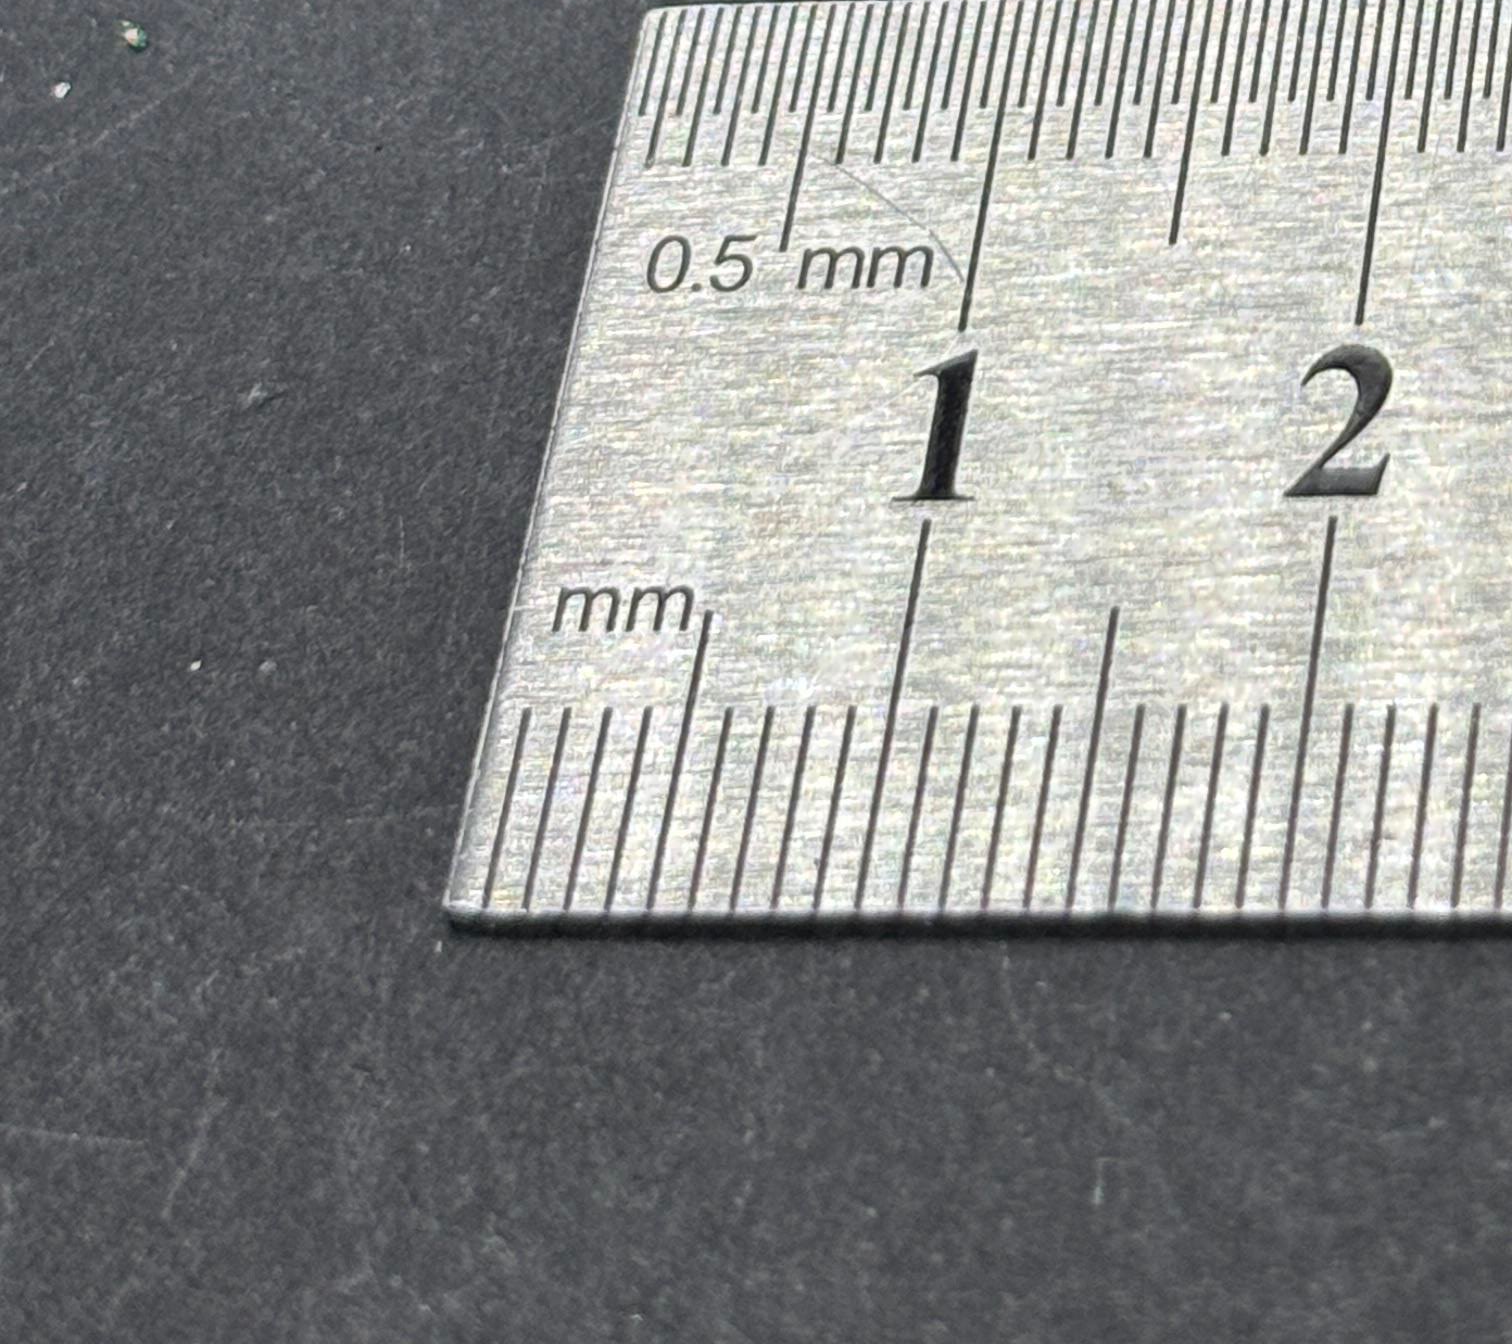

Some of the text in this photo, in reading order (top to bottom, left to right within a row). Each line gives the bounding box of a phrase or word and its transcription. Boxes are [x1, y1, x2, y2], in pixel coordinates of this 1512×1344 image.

[645, 234, 935, 292] 0.5 mm
[891, 349, 977, 501] 1
[1283, 343, 1394, 498] 2
[551, 583, 695, 633] mm
